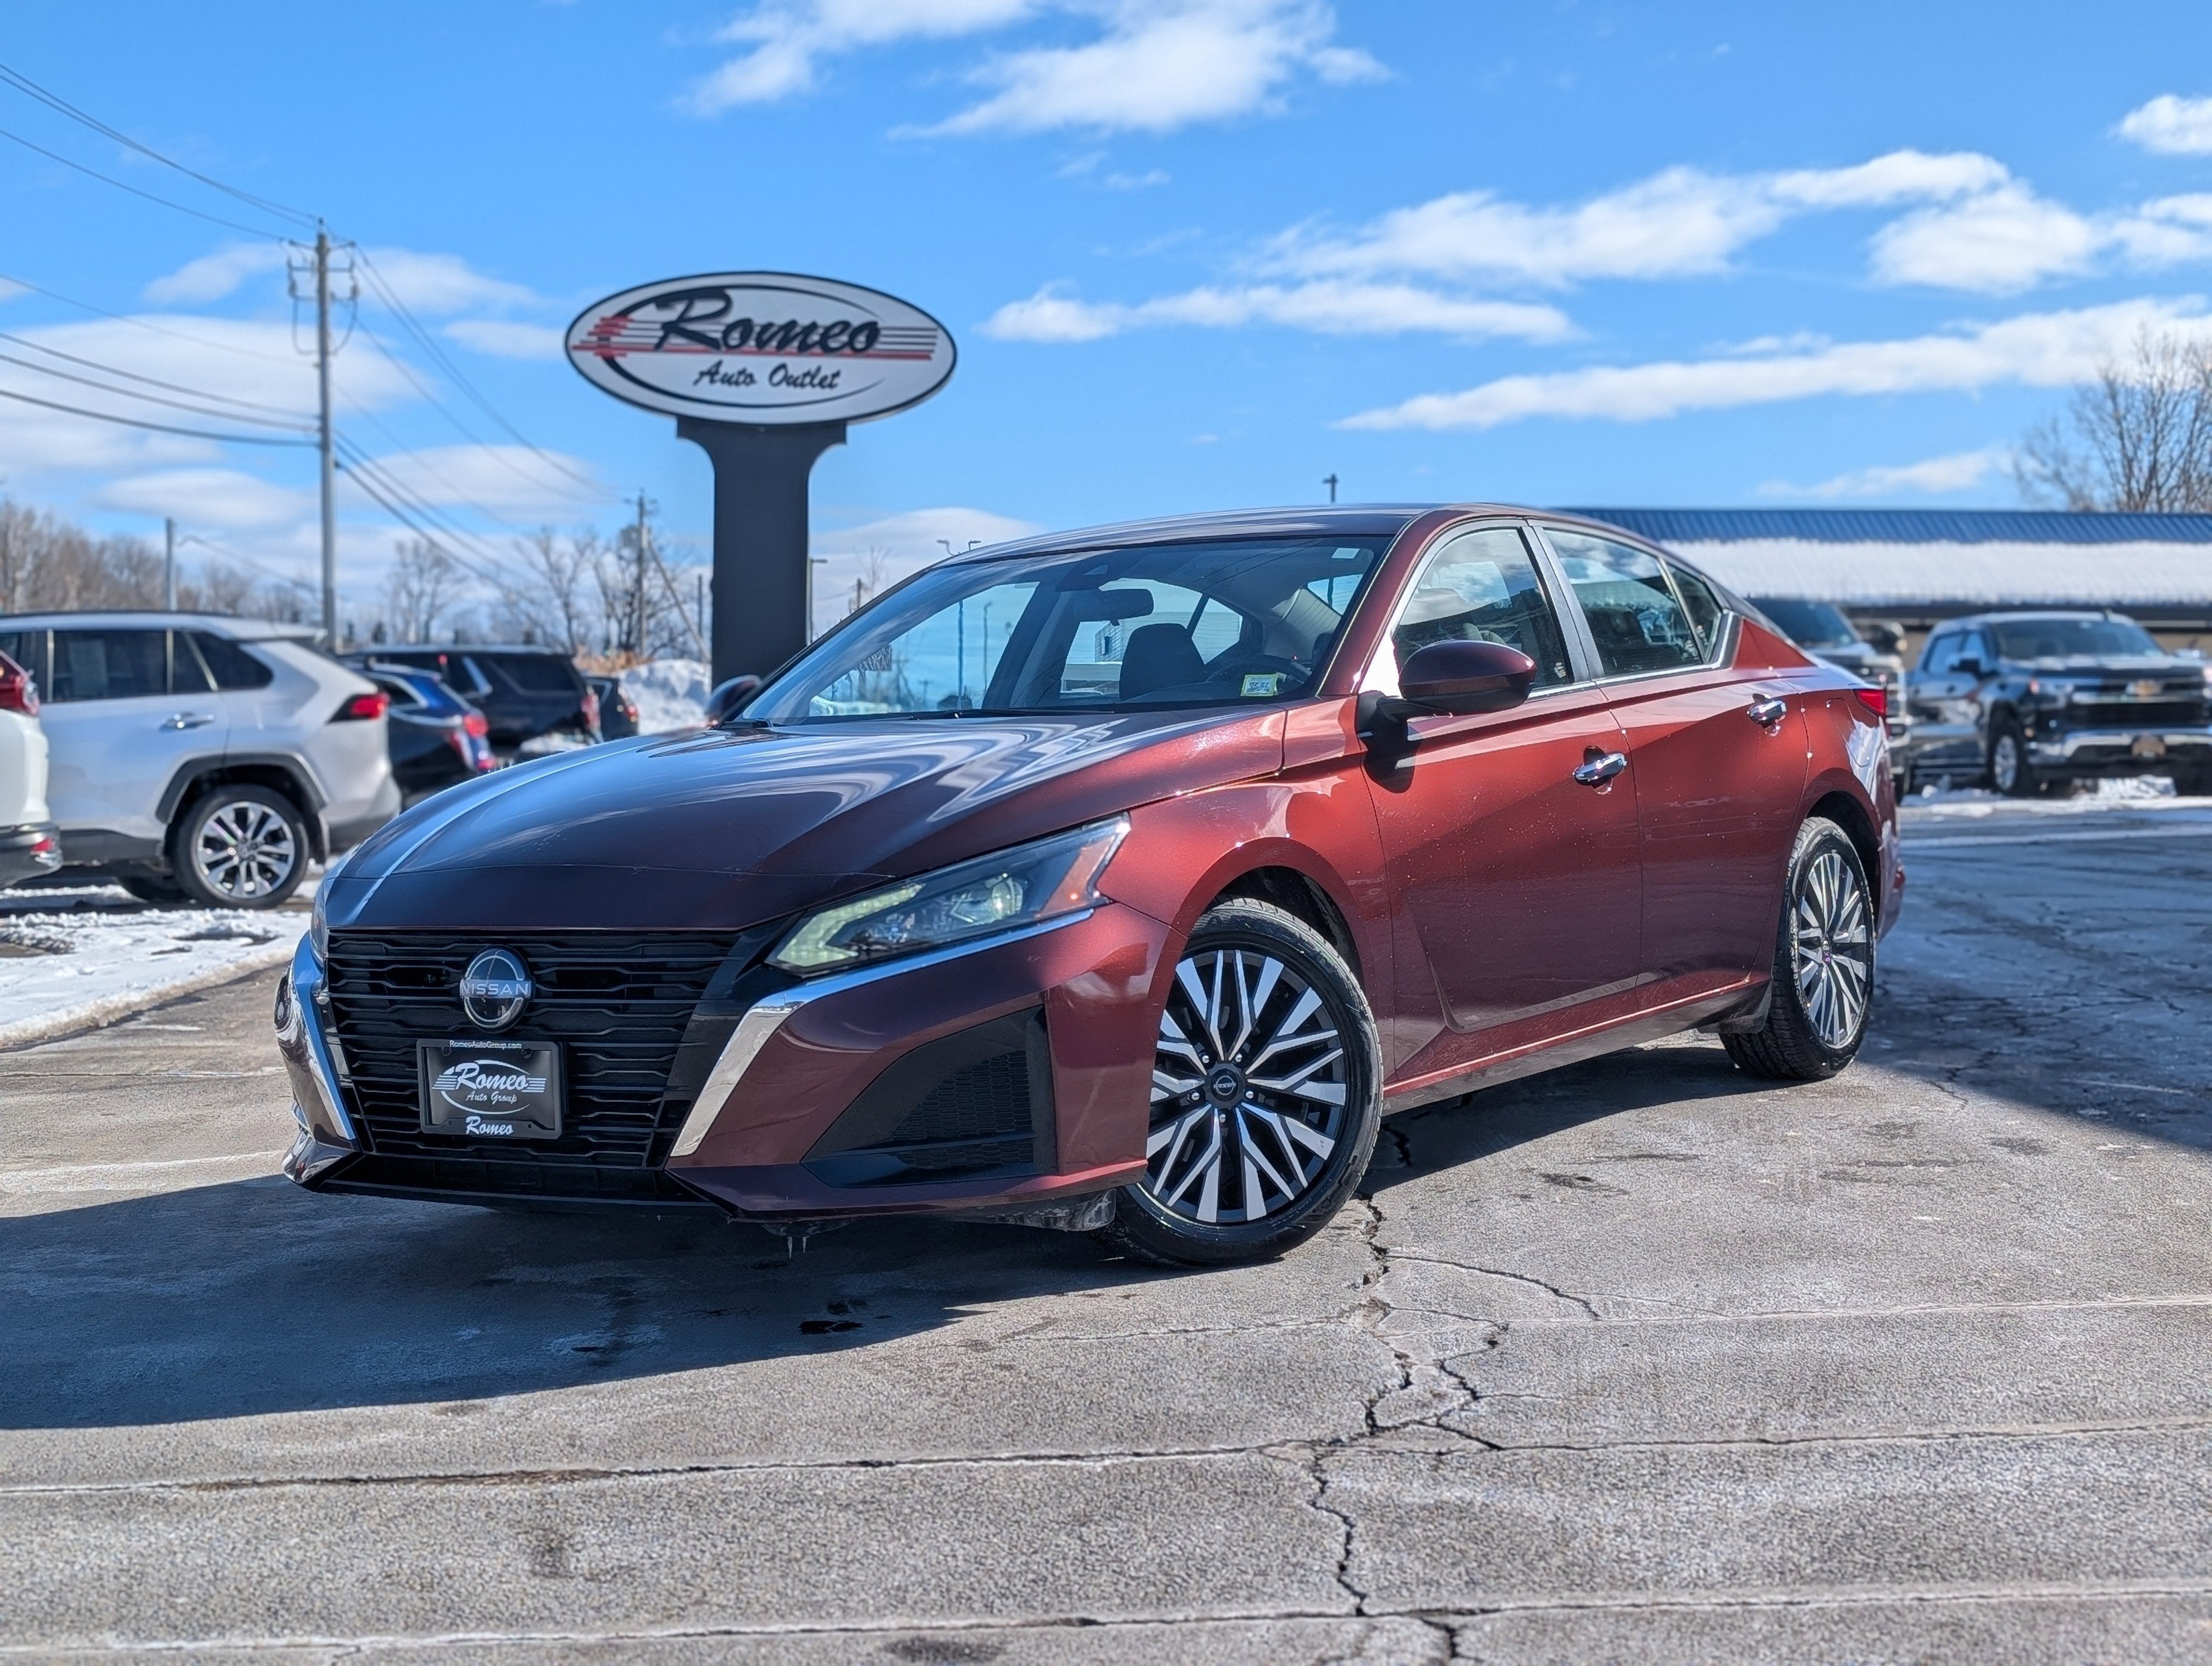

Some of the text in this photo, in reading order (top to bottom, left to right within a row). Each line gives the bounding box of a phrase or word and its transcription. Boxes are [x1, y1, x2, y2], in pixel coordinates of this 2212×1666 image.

[651, 287, 881, 353] Romeo
[692, 360, 841, 389] Auto Outlet
[461, 982, 529, 996] NISSAN
[455, 1062, 528, 1090] Romeo
[465, 1090, 517, 1105] Auto Group
[465, 1116, 513, 1135] Romeo
